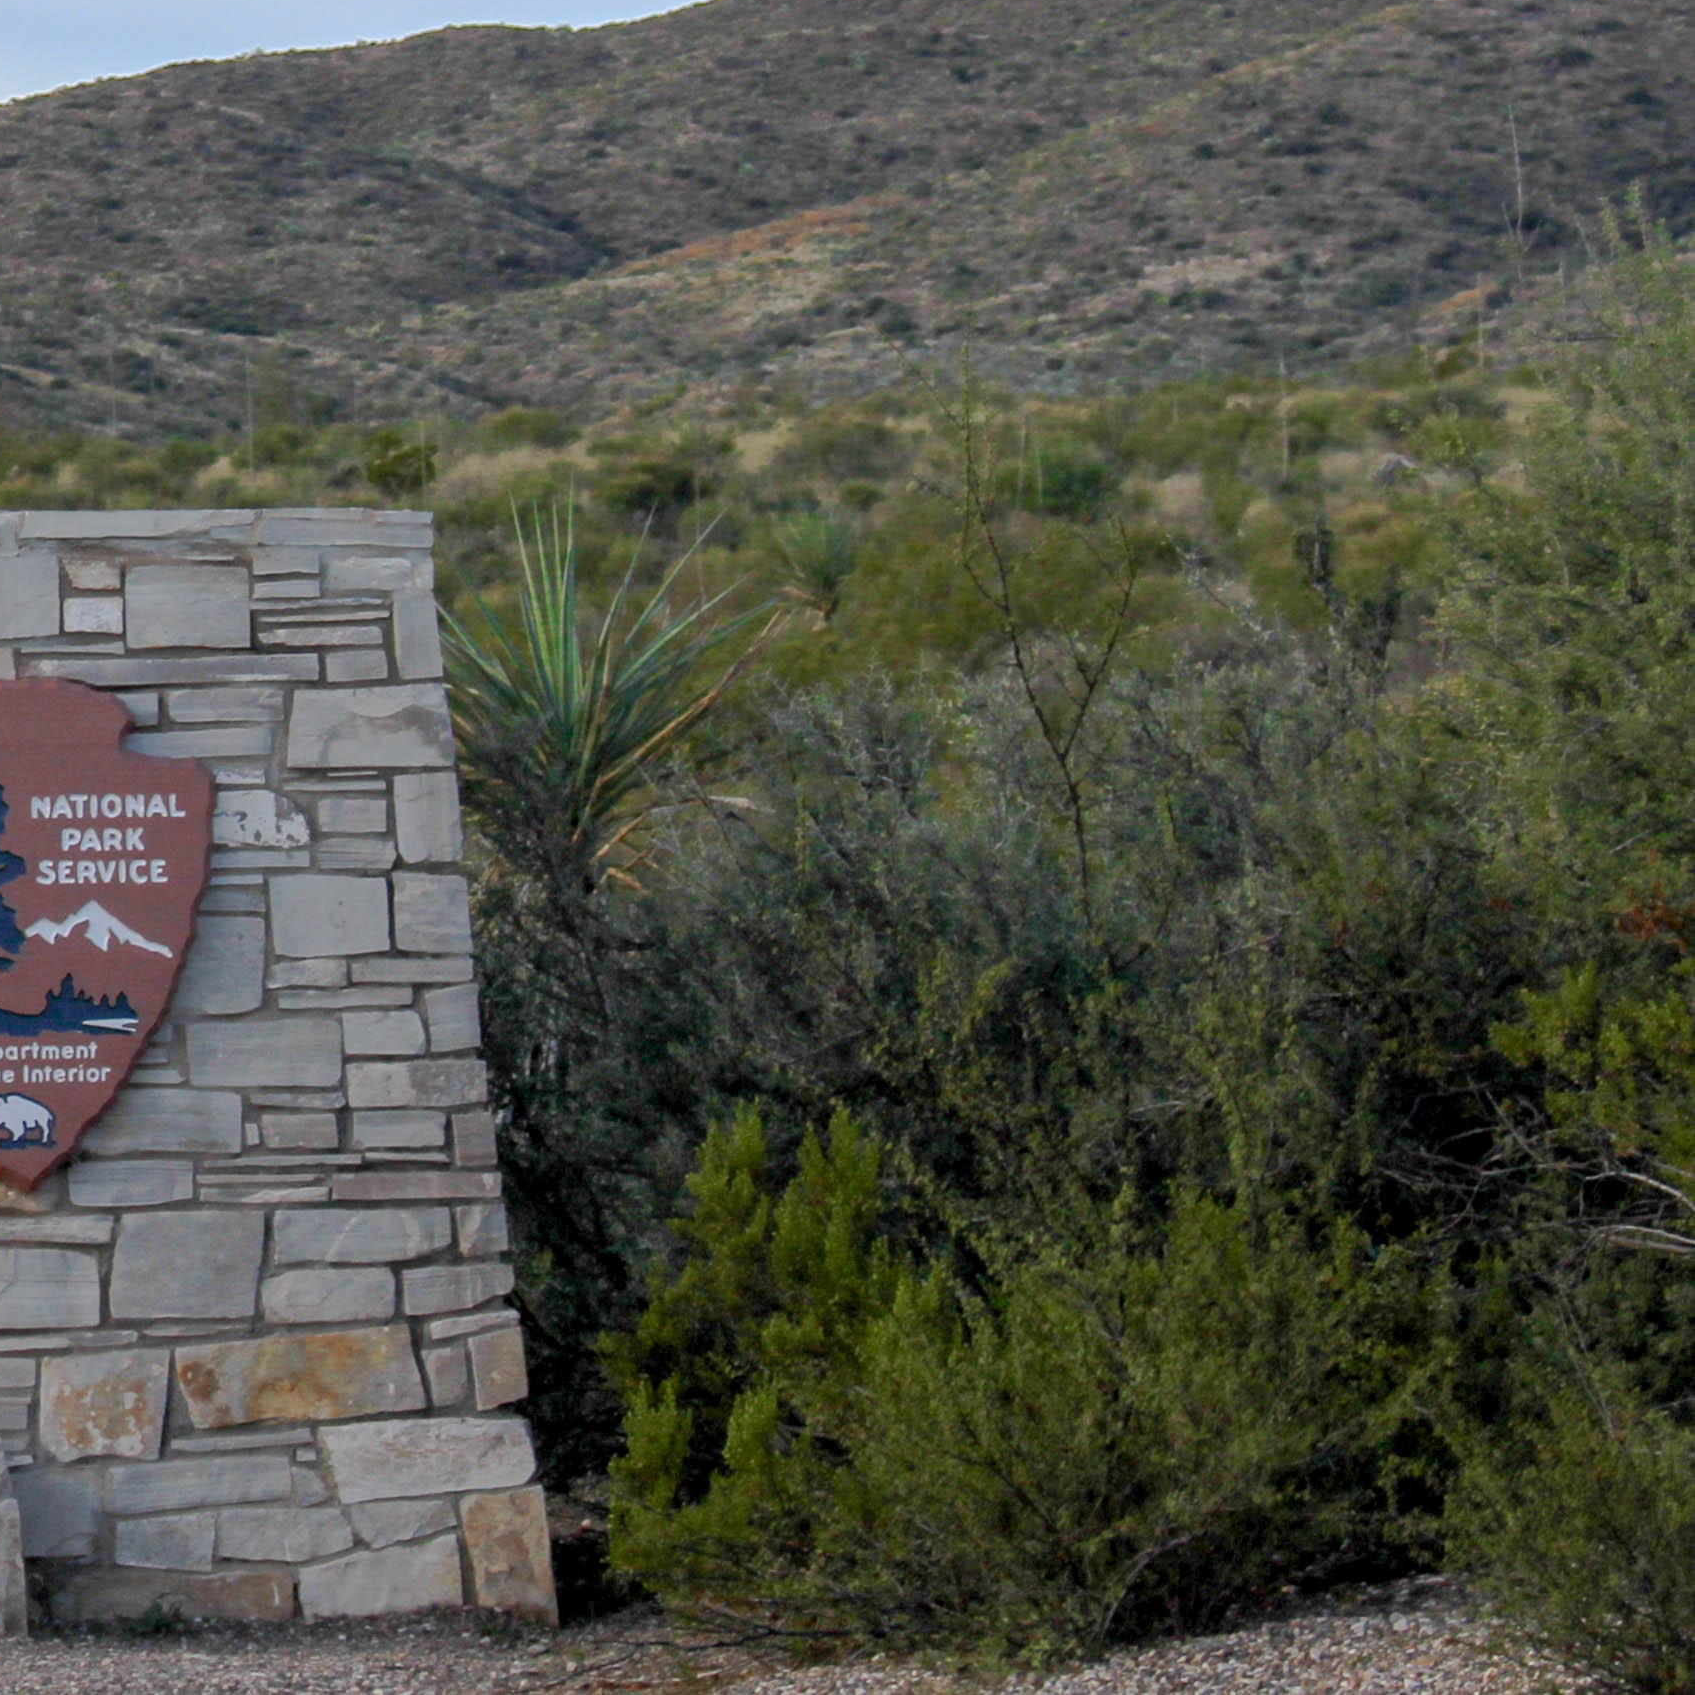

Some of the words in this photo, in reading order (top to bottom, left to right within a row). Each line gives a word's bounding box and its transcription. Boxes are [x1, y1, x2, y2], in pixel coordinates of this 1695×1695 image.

[30, 793, 187, 820] NATIONAL
[61, 827, 146, 852] PARK
[35, 859, 170, 885] SERVICE
[22, 1063, 112, 1084] Interior
